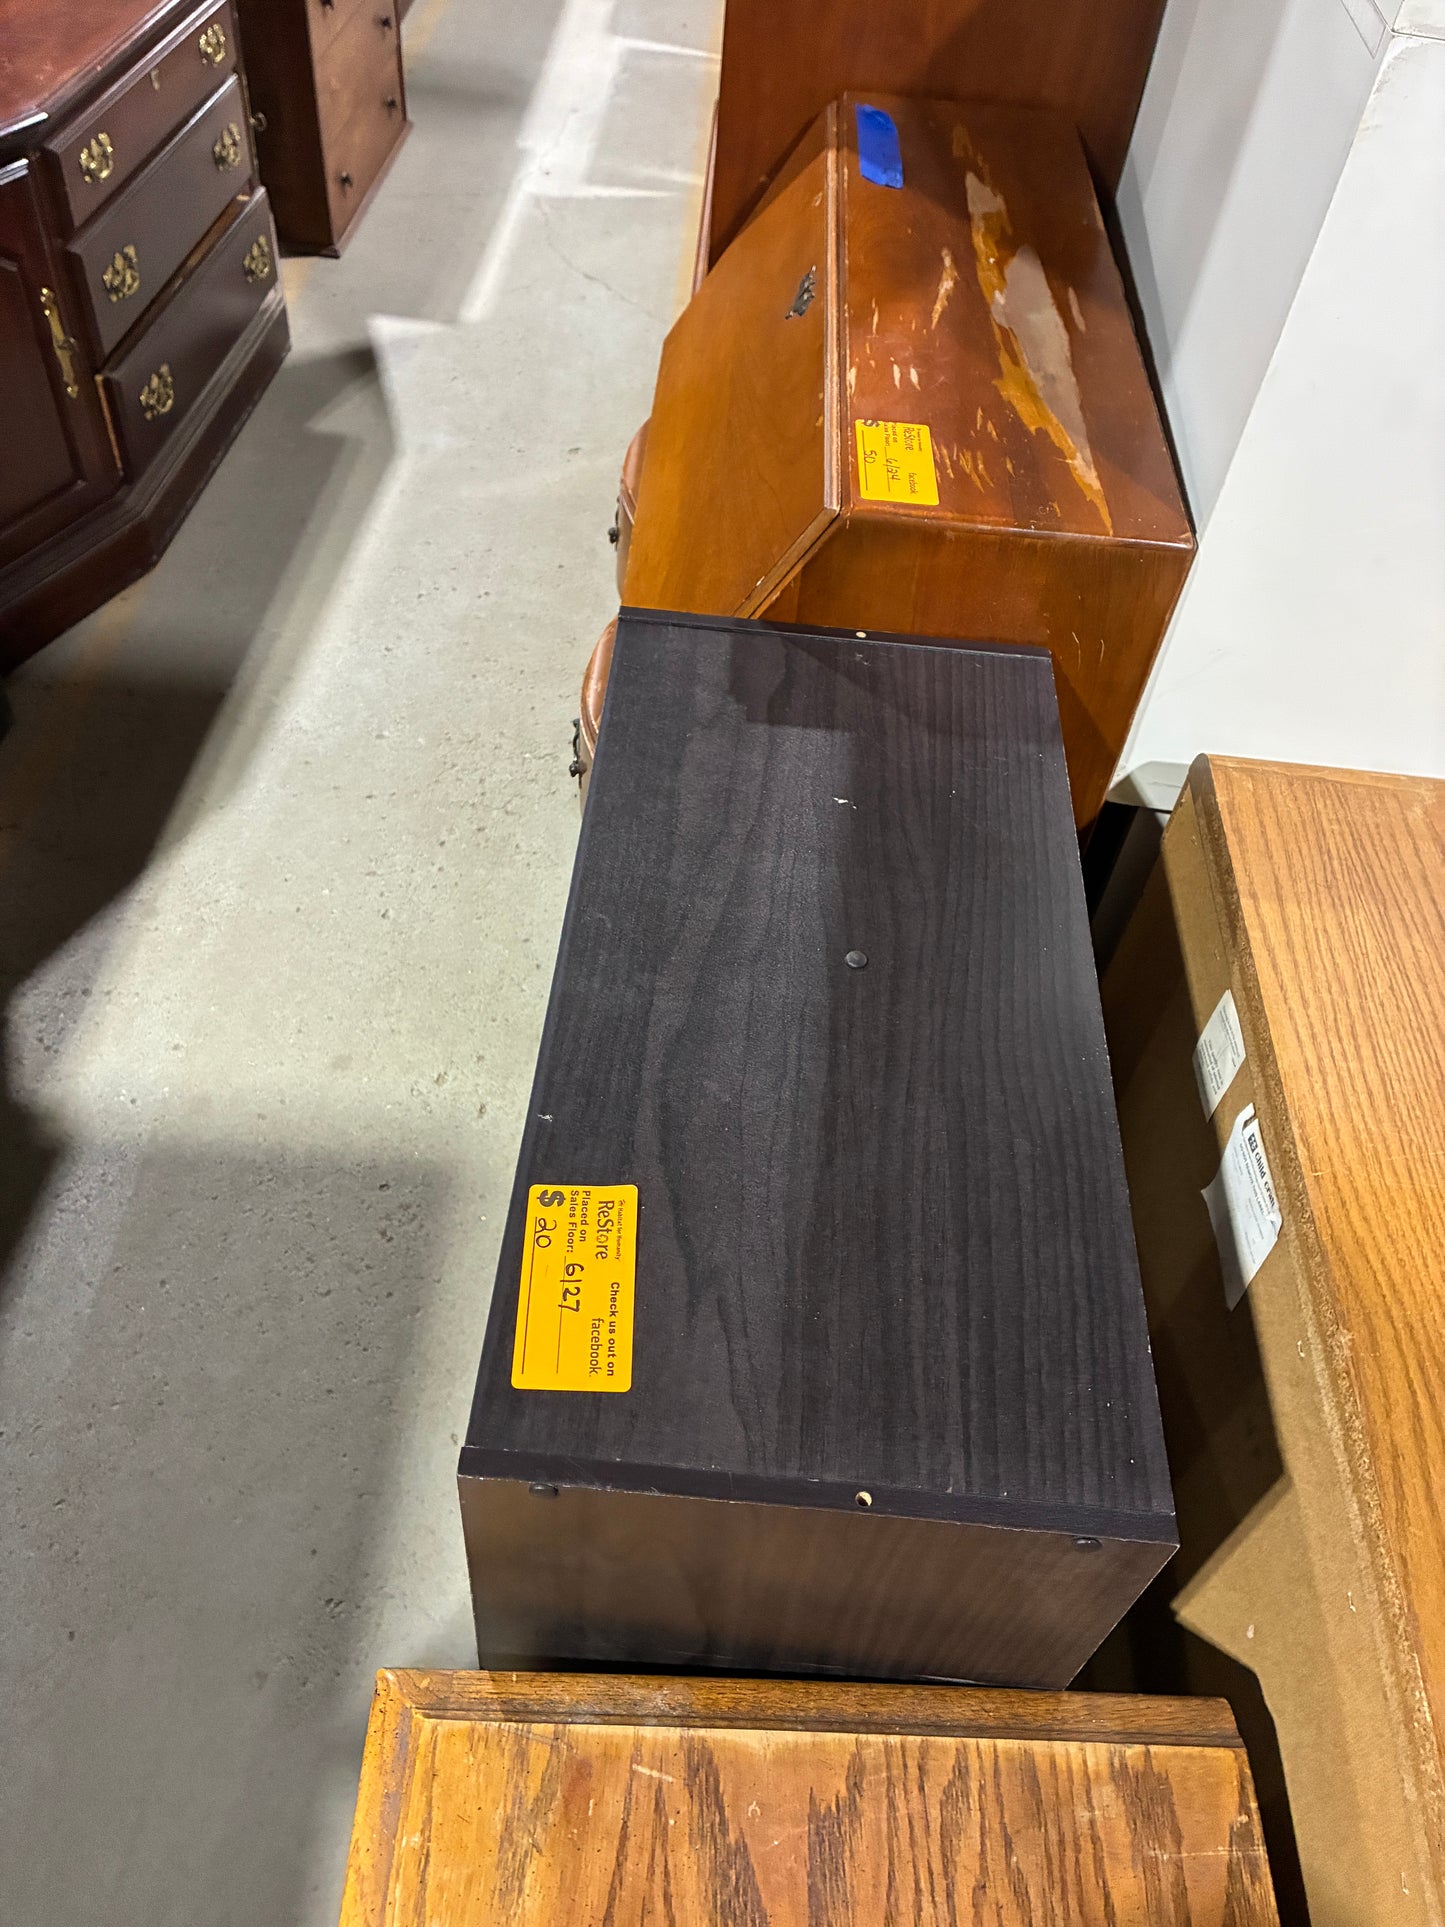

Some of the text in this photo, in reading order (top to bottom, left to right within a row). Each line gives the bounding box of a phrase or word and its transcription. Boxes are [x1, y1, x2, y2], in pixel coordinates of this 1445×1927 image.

[864, 450, 878, 464] 50
[903, 426, 916, 451] ReStore
[883, 457, 901, 481] 6/24
[535, 1189, 566, 1248] $ 20
[566, 1190, 580, 1253] Sales Floor:
[579, 1190, 591, 1242] Placed on
[595, 1200, 615, 1260] ReStore
[614, 1207, 624, 1260] Habitat for Humanity
[606, 1281, 620, 1377] Check us out on
